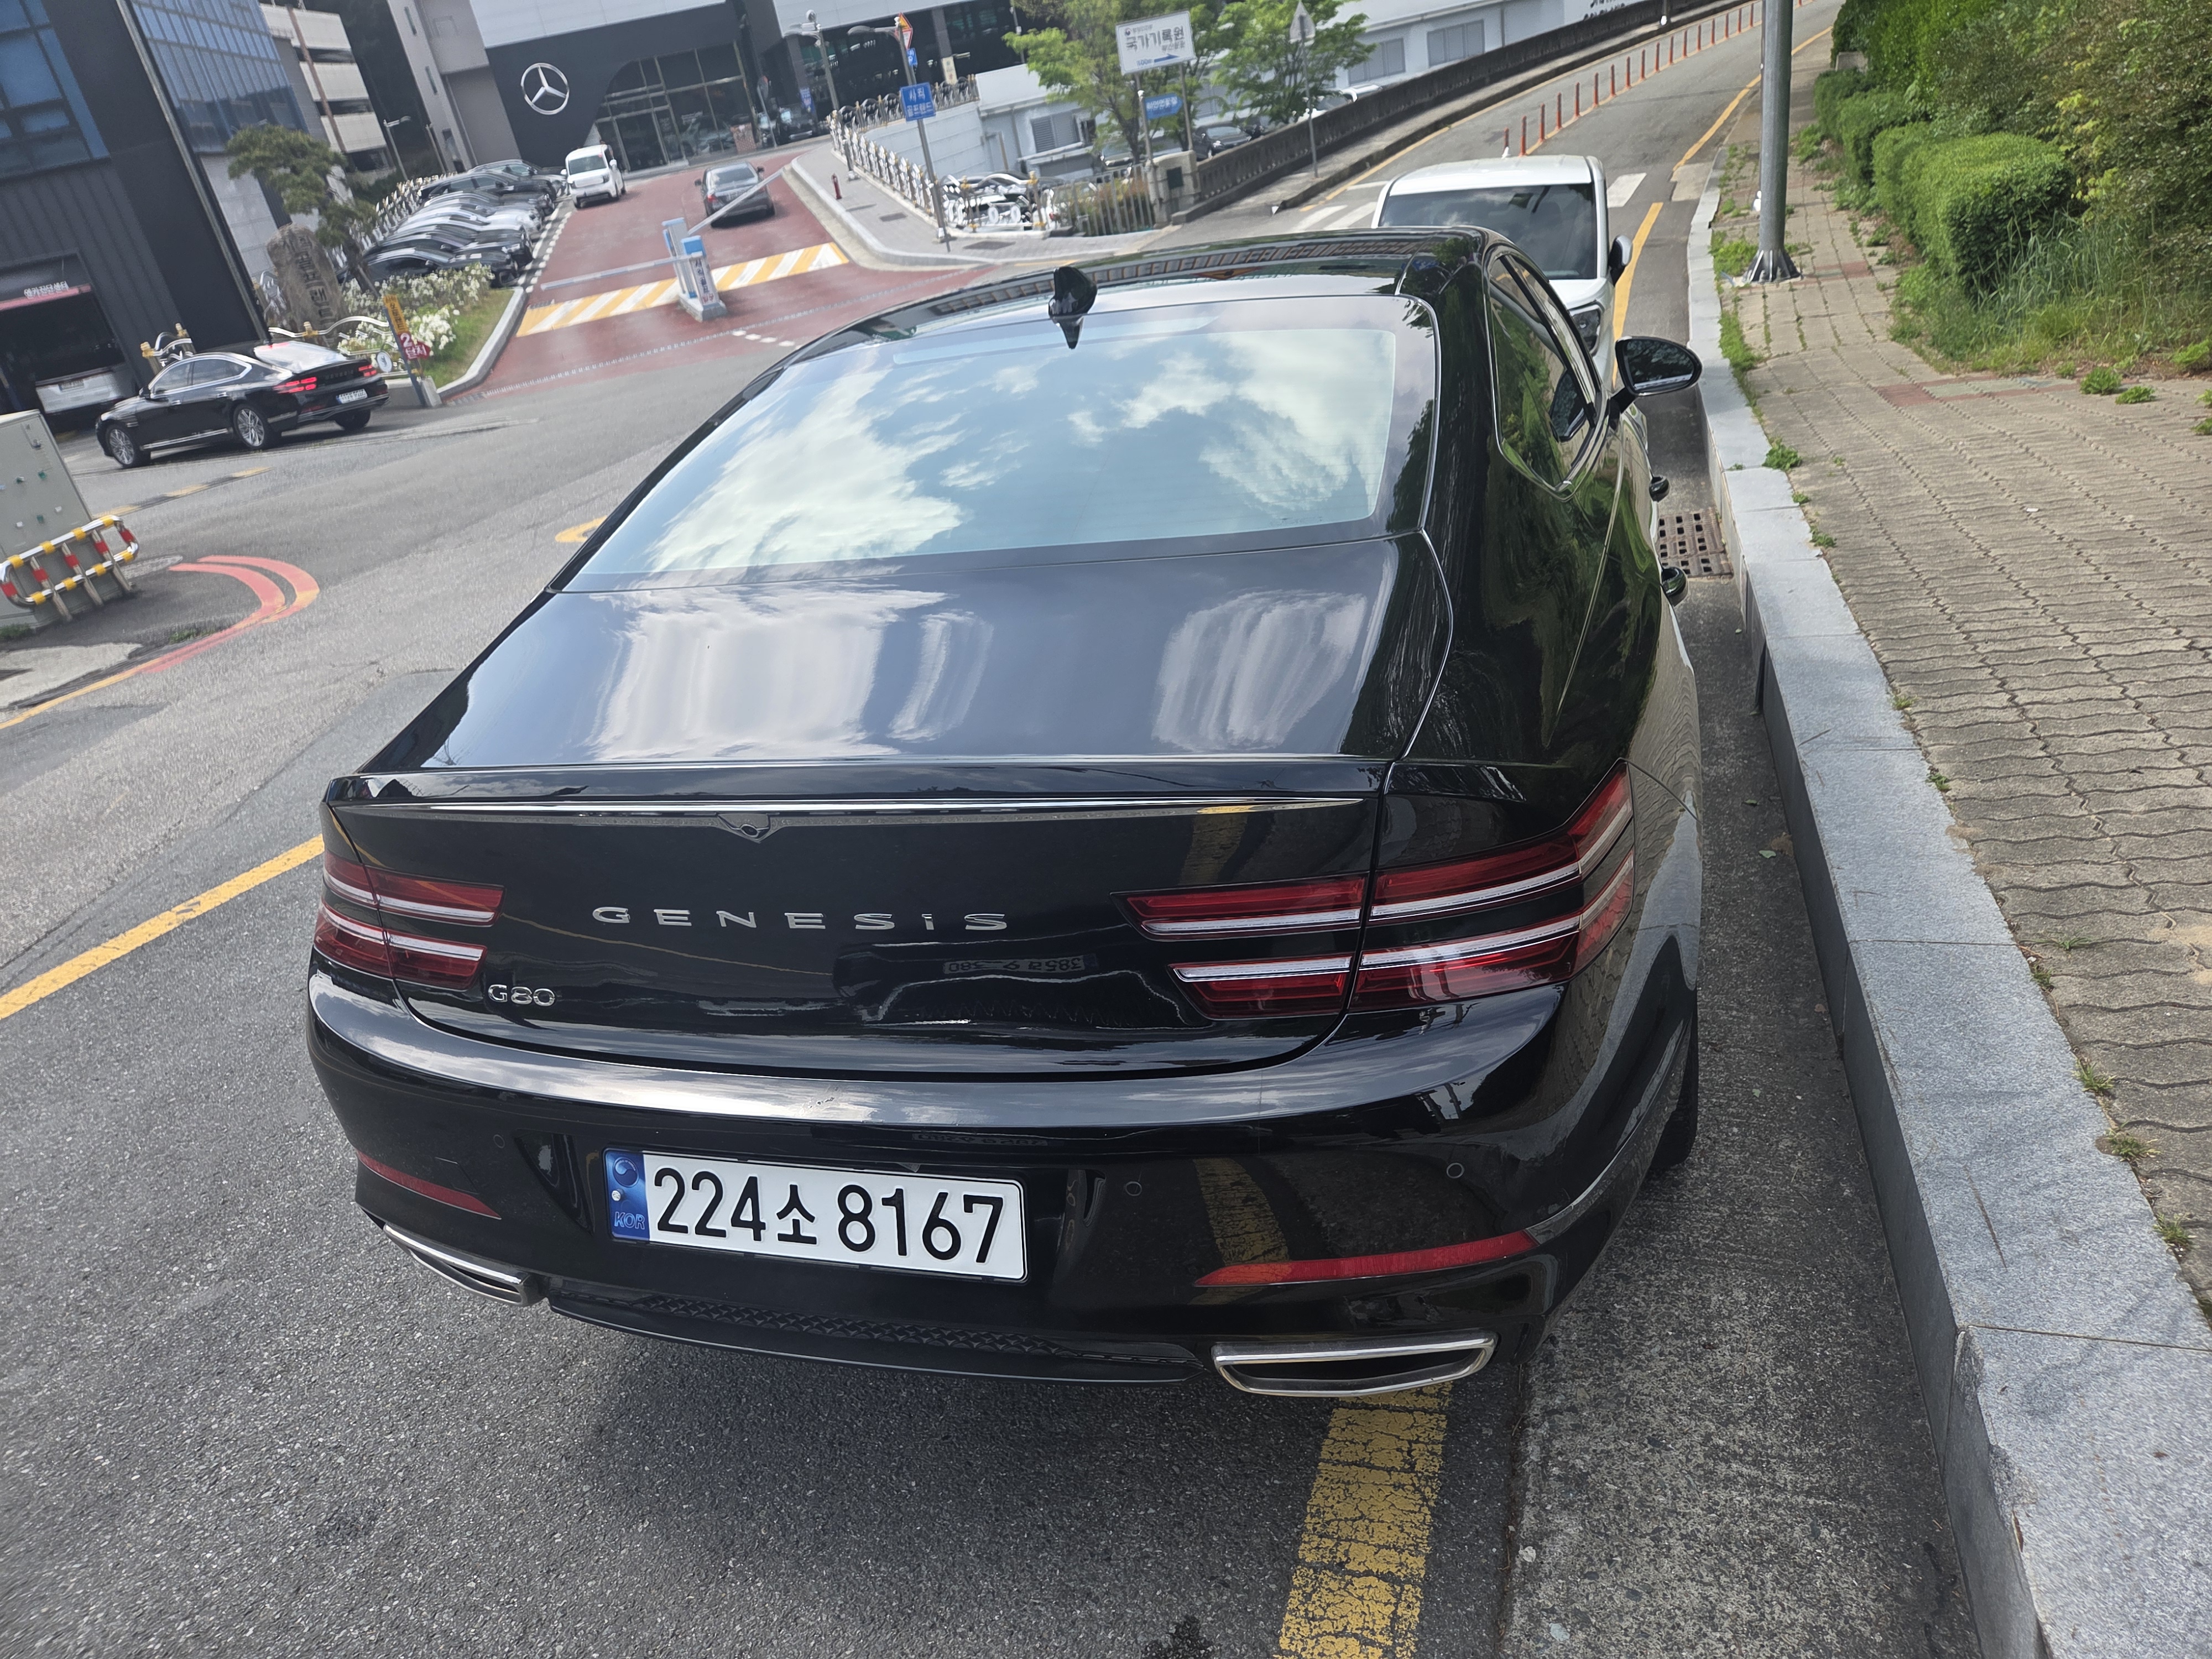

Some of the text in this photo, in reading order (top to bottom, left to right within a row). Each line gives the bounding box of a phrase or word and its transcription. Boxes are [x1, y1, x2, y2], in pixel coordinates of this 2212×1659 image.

[1126, 25, 1185, 52] 국가기록원
[909, 87, 926, 103] 사직
[400, 332, 413, 347] 2
[487, 984, 556, 1006] G80
[614, 1211, 645, 1230] KOR
